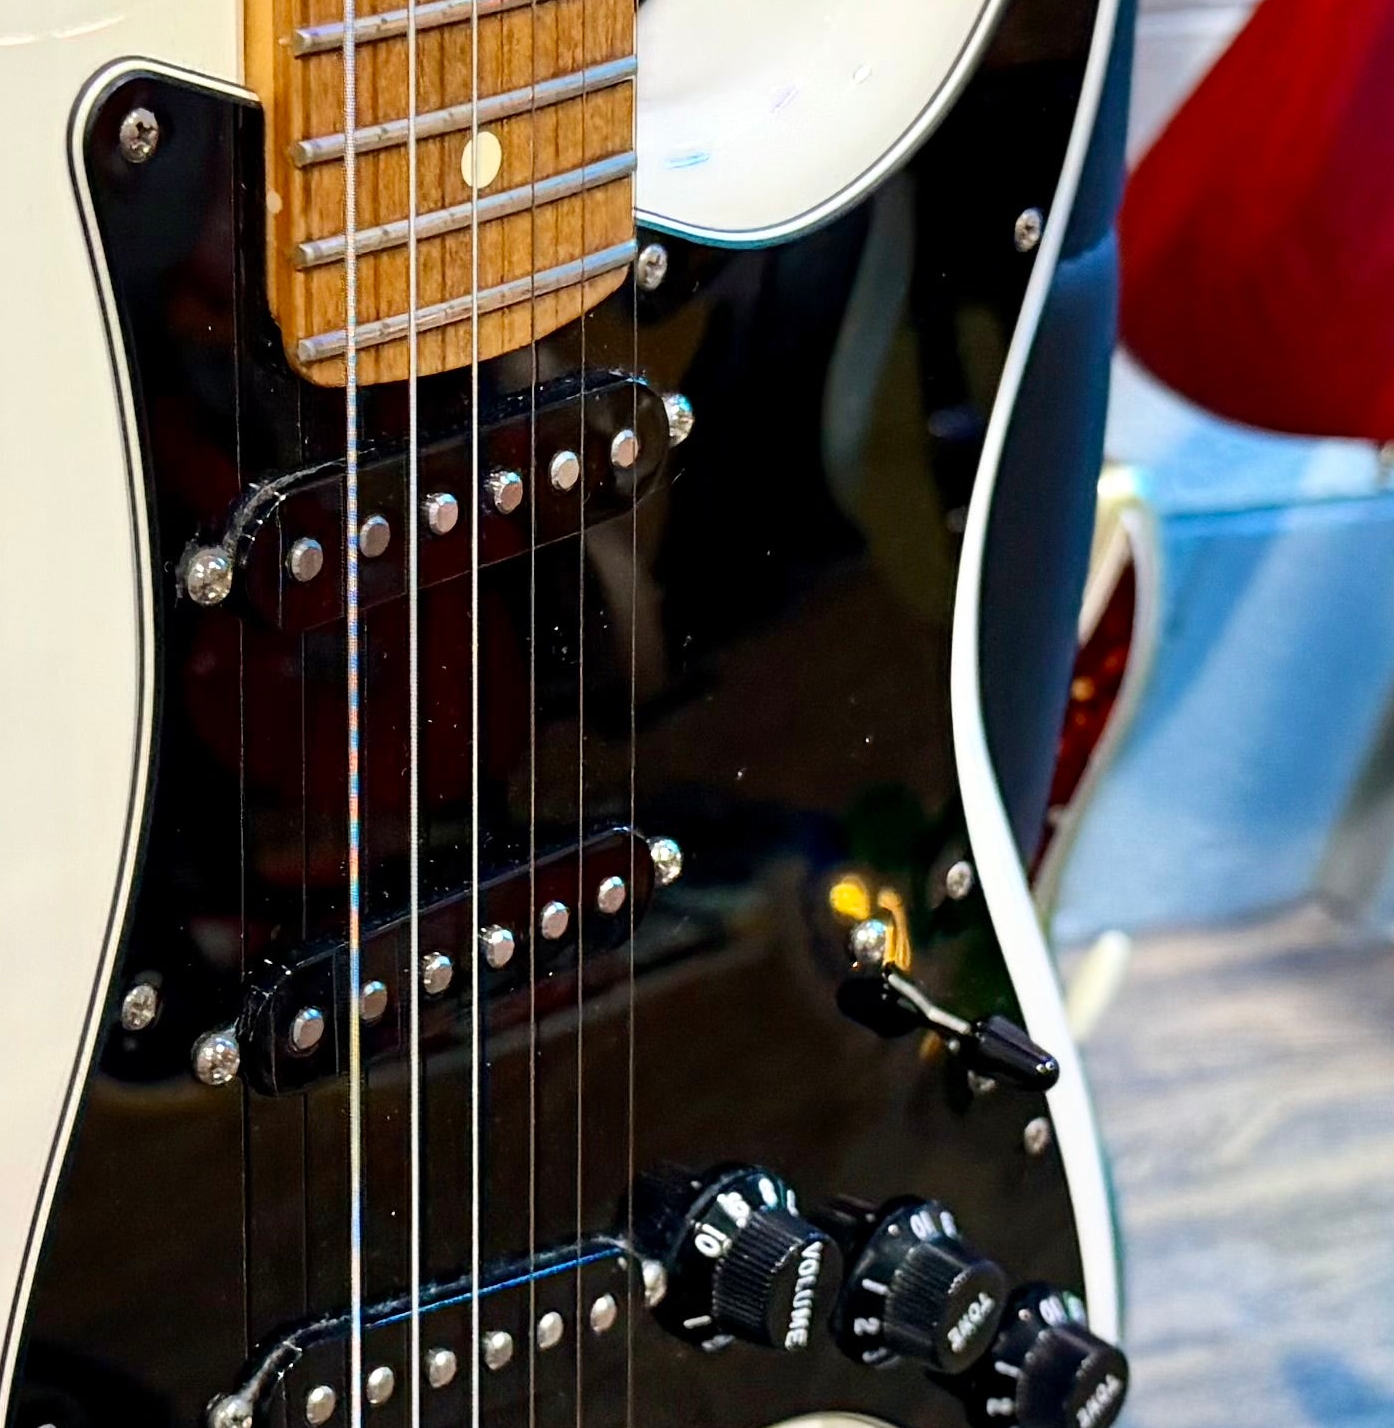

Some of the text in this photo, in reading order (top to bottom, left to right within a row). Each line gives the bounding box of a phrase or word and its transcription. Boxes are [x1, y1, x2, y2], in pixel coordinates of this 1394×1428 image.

[694, 1222, 732, 1258] 10
[784, 1241, 823, 1351] VOLUME
[947, 1292, 995, 1353] TONE
